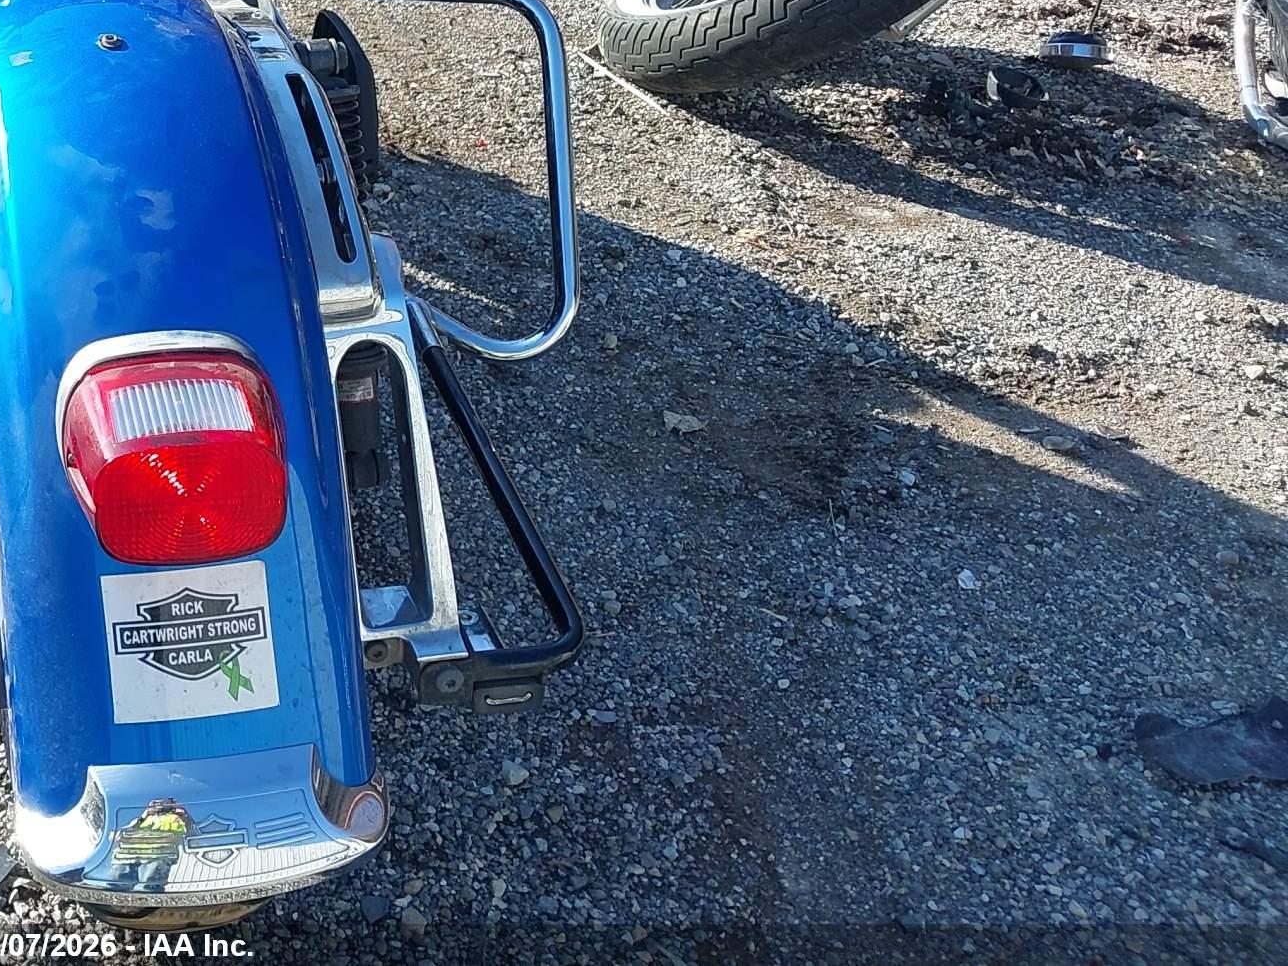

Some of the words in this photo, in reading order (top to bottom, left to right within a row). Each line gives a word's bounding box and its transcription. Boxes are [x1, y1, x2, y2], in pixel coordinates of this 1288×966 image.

[171, 601, 204, 616] RICK
[123, 624, 204, 645] CARTWRIGHT
[207, 618, 256, 636] STRONG
[168, 649, 214, 665] CARLA
